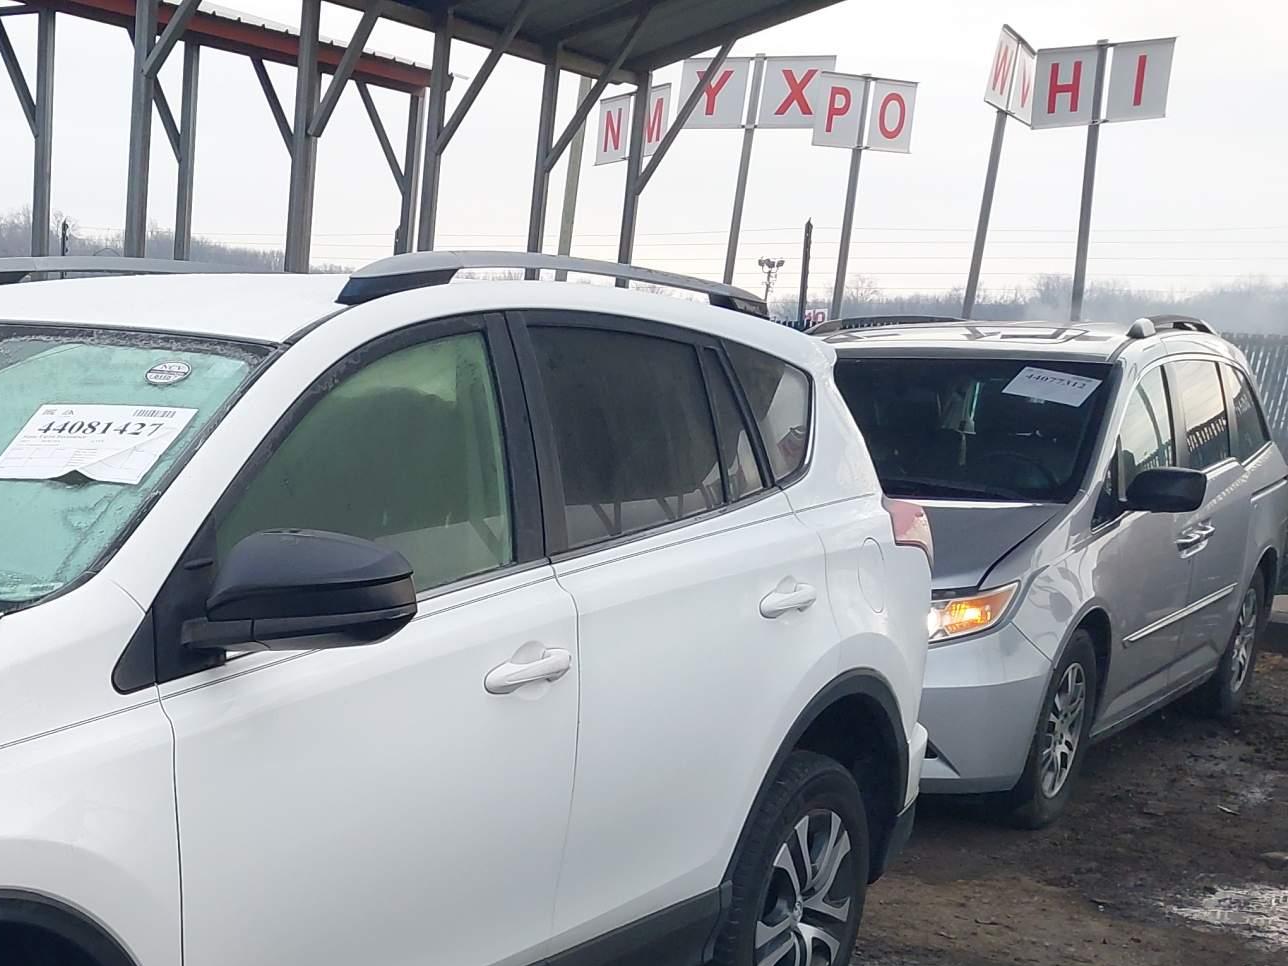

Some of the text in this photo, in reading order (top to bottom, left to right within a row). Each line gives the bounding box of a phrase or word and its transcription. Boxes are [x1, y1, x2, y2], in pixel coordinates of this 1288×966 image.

[696, 68, 818, 116] Y X
[992, 41, 1014, 95] W
[1047, 54, 1148, 115] H I
[603, 107, 623, 152] N
[825, 87, 906, 139] P O
[38, 420, 164, 437] 44081427
